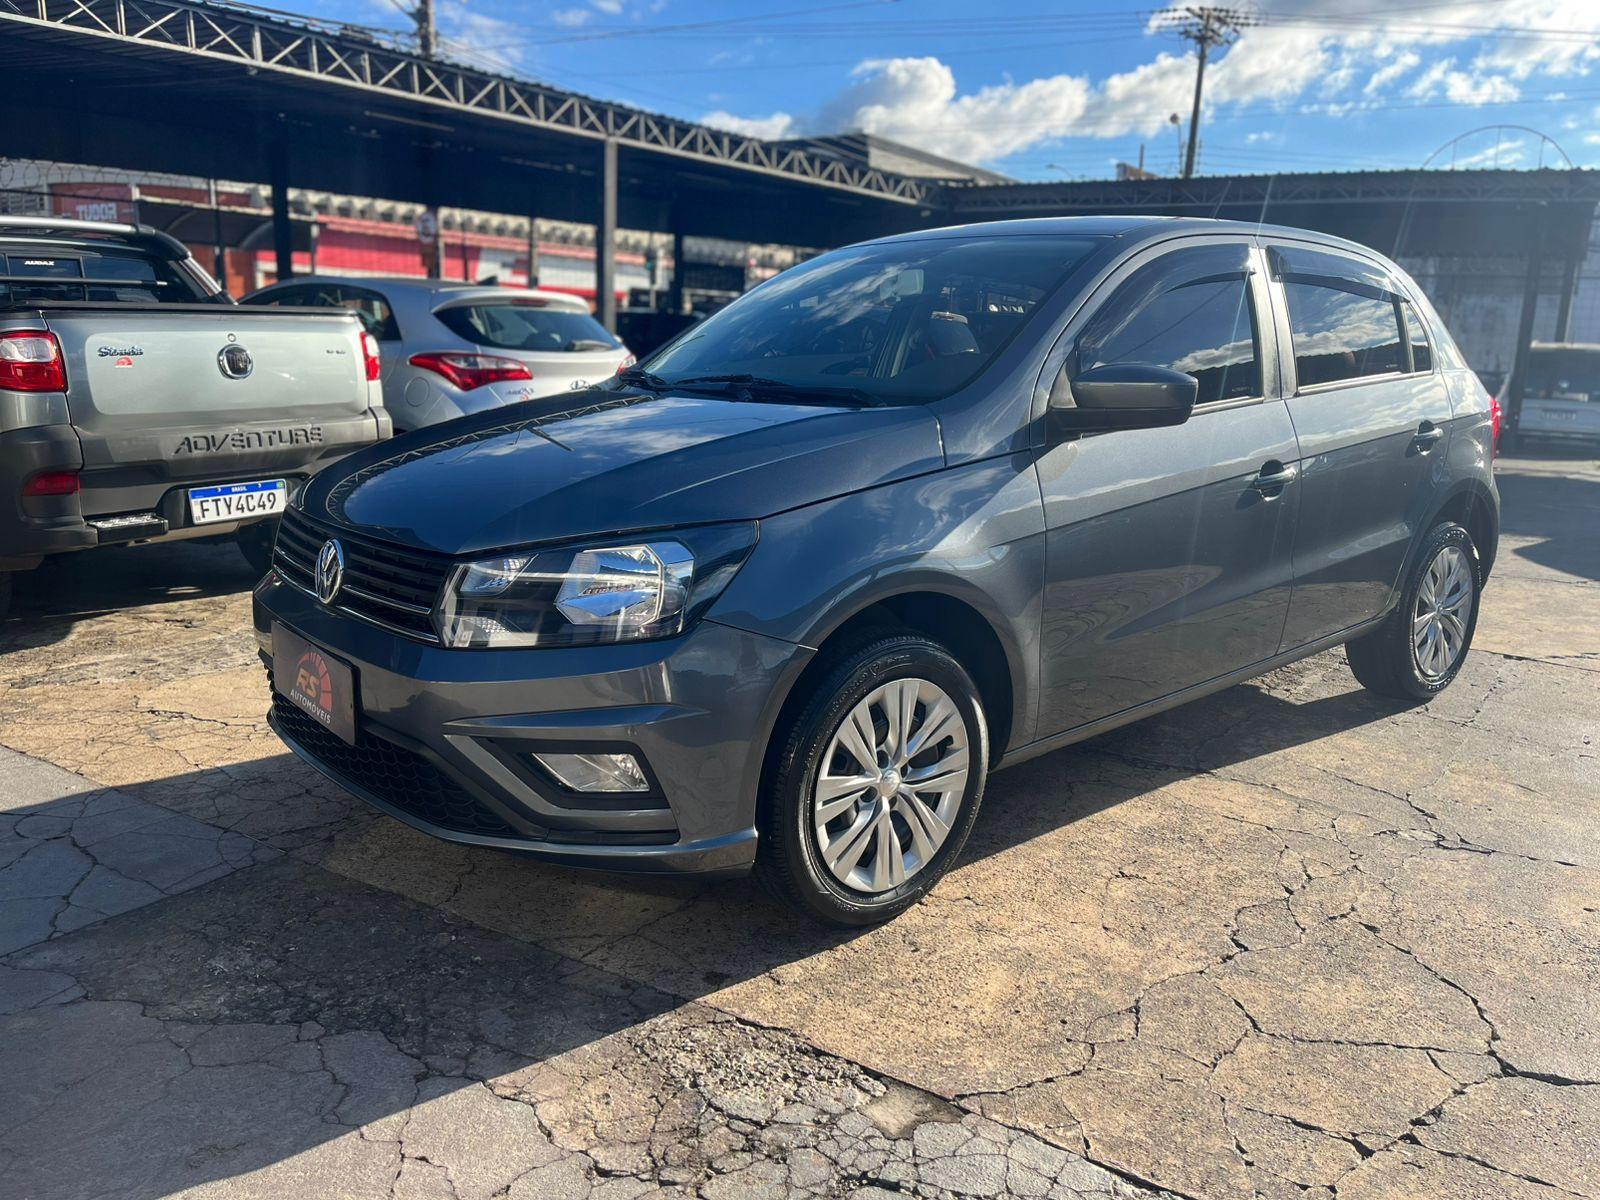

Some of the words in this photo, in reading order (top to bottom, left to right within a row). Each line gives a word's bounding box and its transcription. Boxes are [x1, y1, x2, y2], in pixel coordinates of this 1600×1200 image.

[76, 202, 117, 221] TUDOR
[174, 427, 322, 454] ADVENTURE
[200, 492, 276, 519] FTY4C49
[296, 667, 320, 698] RS
[290, 689, 331, 724] AUTOMÓVEIS
